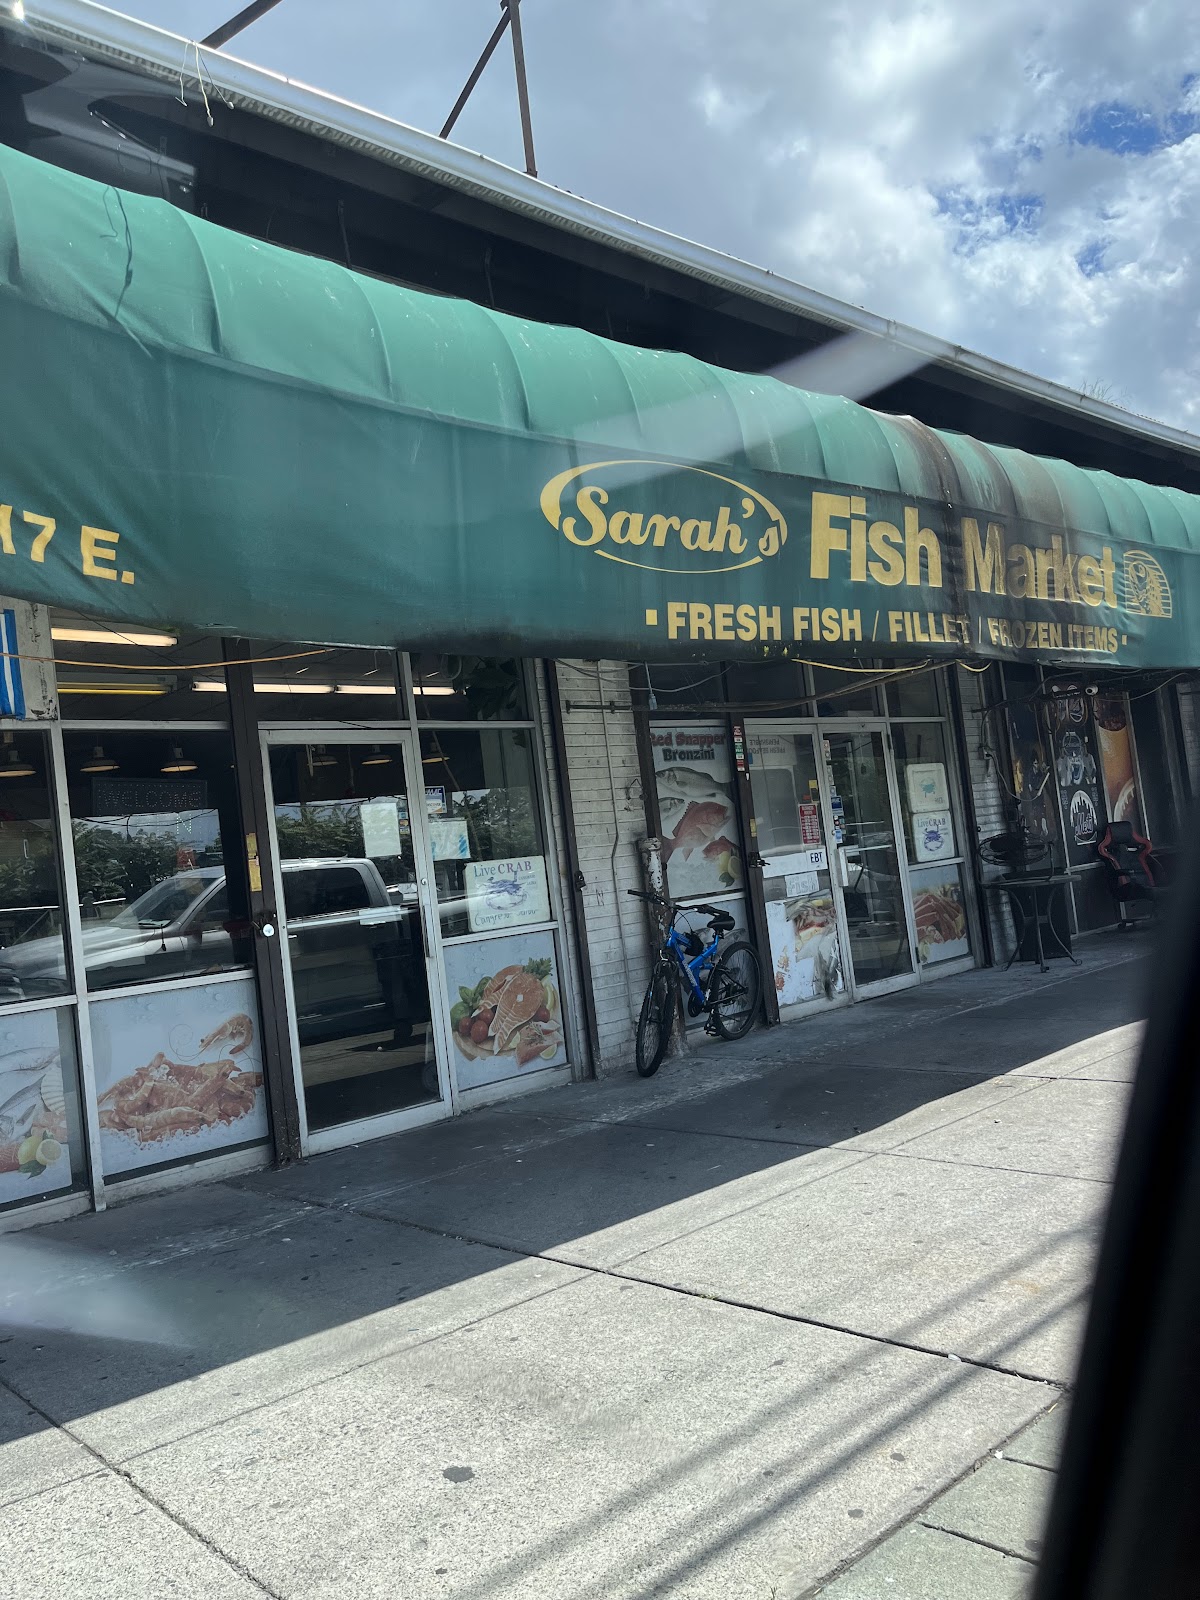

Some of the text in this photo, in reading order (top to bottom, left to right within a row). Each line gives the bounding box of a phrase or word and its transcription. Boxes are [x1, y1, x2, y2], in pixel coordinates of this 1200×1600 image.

[80, 525, 135, 585] E.
[562, 485, 1118, 609] Sarah's Fish Market
[667, 601, 782, 641] FRESH
[793, 606, 863, 643] FISH
[887, 610, 971, 644] FILLET
[987, 617, 1062, 649] FROZEN
[1067, 623, 1119, 653] ITEMS
[650, 732, 726, 749] Red Snapper
[662, 747, 716, 762] Bronzini
[103, 789, 202, 808] WELCOME
[498, 860, 532, 874] CRAB
